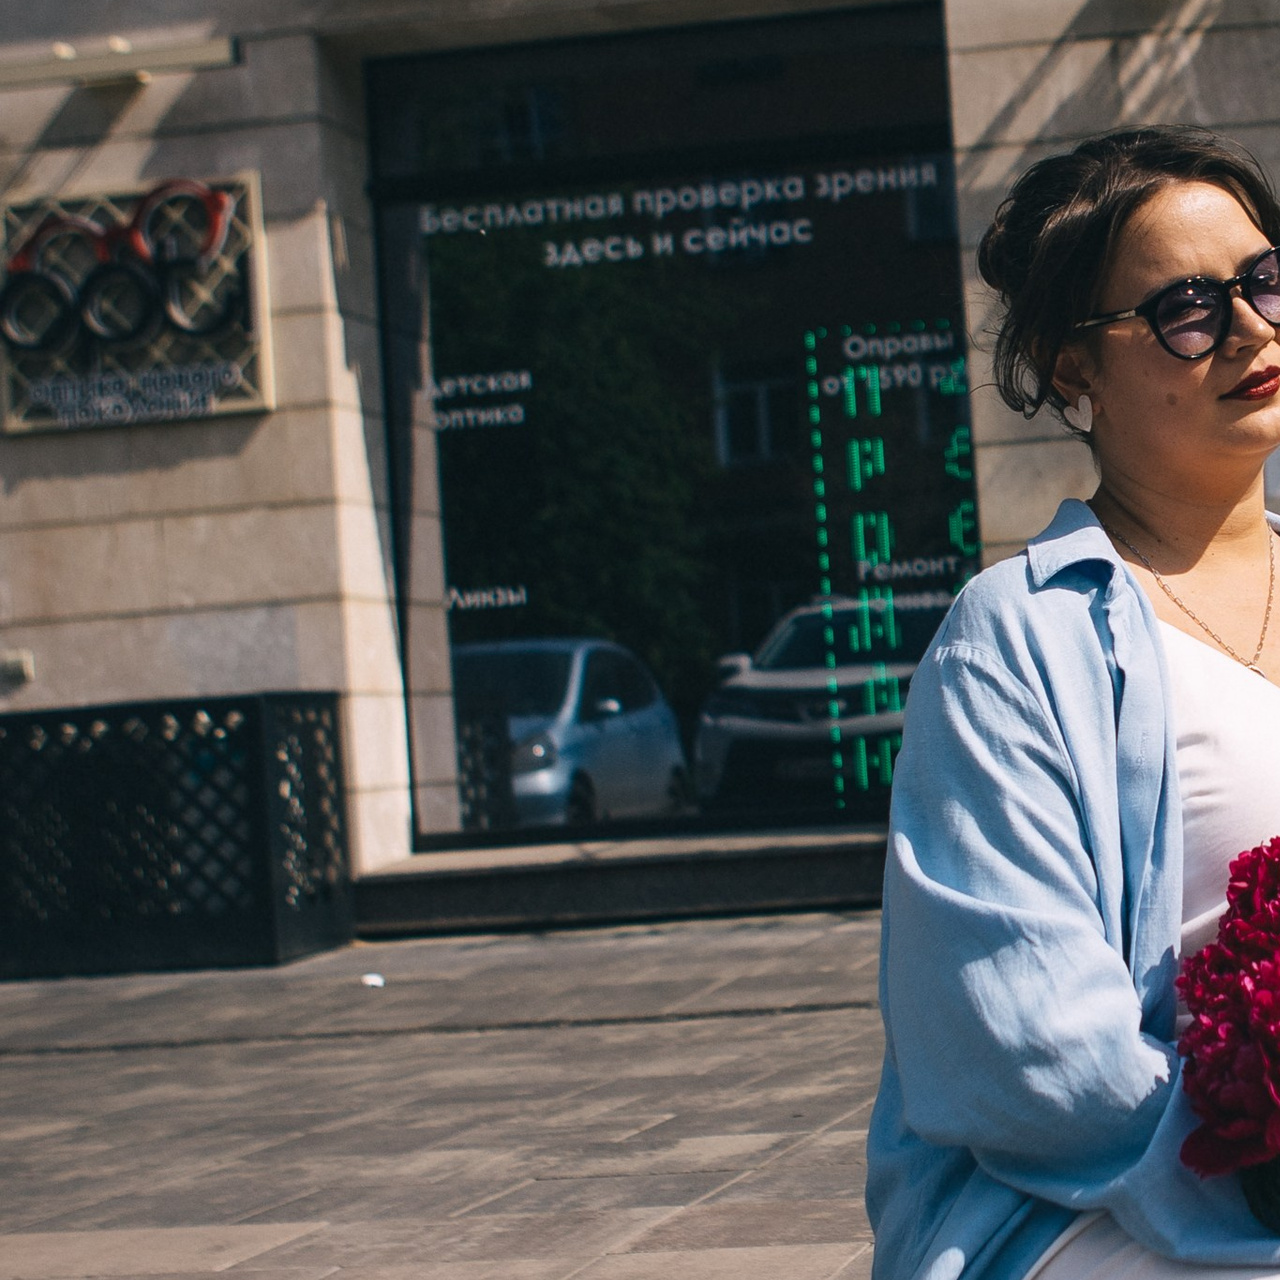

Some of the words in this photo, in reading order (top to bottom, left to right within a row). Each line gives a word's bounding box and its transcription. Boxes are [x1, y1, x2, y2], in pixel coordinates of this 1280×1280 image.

[420, 192, 624, 236] Бесплатная
[633, 173, 804, 219] проверка
[815, 162, 938, 204] зрения
[543, 235, 643, 269] здесь
[652, 230, 674, 255] и
[681, 216, 813, 255] сейчас
[843, 331, 954, 361] Оправы
[857, 556, 957, 582] Ремонт
